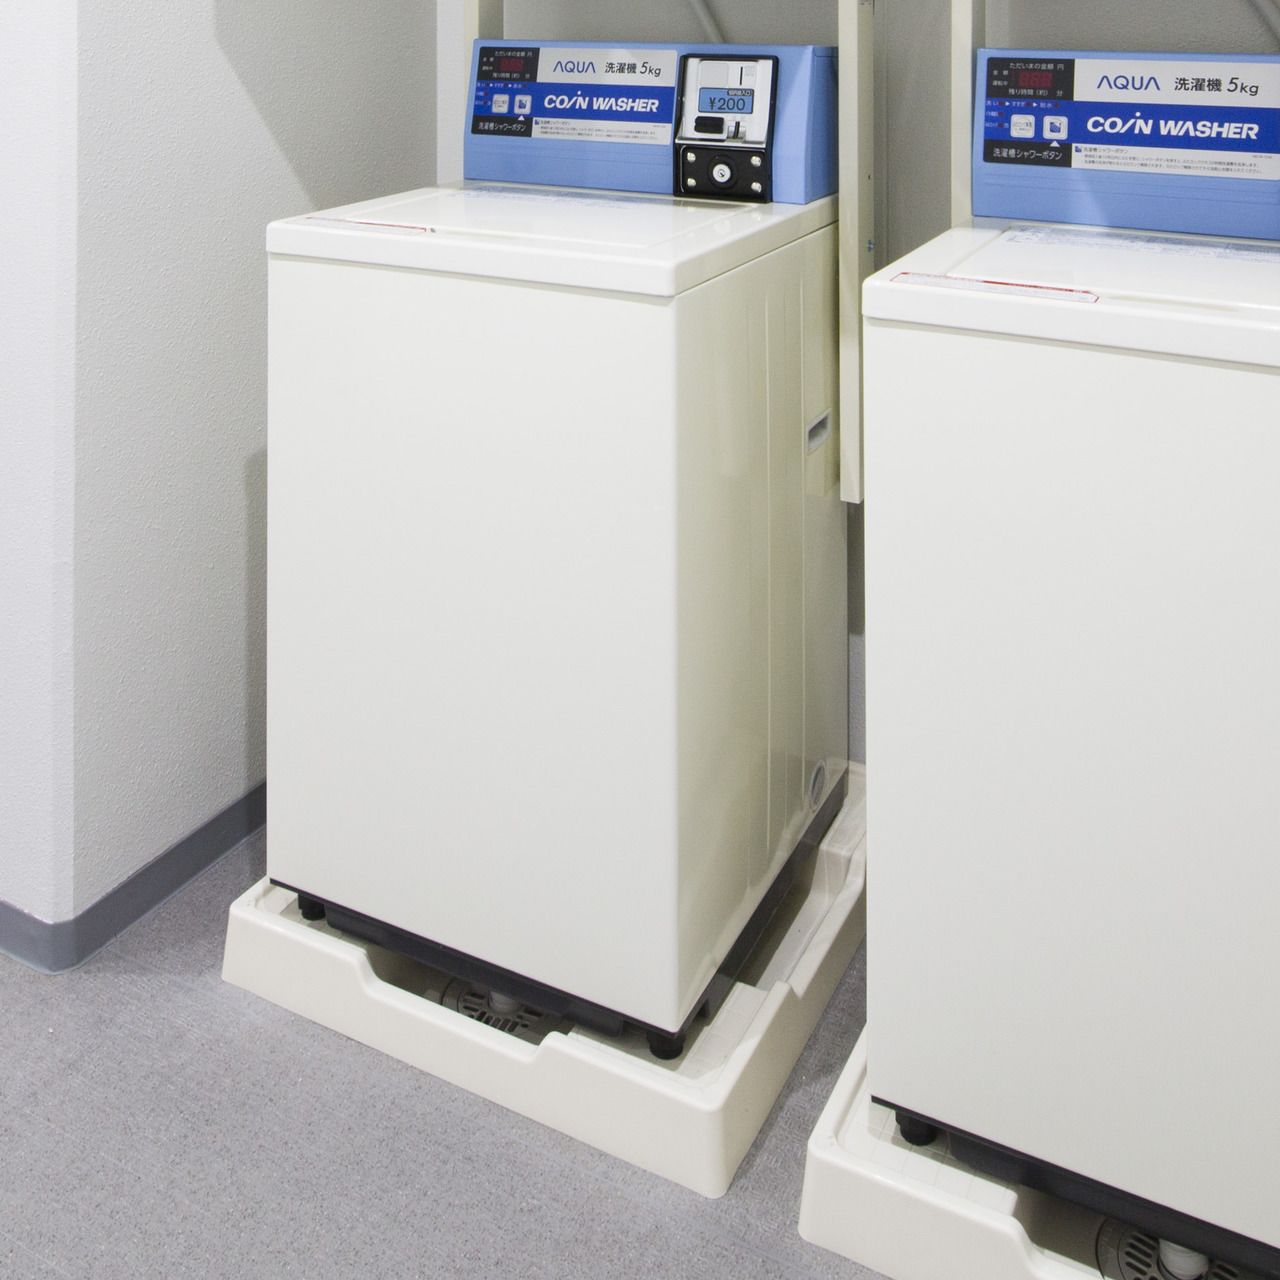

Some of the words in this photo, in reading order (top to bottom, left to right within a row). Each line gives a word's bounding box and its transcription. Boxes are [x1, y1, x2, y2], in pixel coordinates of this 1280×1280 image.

[553, 61, 596, 74] AQUA
[604, 62, 637, 74] 洗濯機
[640, 61, 662, 77] 5kg
[1097, 75, 1161, 91] AQUA
[1174, 77, 1222, 92] 洗濯機
[1227, 77, 1260, 96] 5kg
[592, 96, 660, 113] WASHER
[708, 96, 746, 111] ¥200
[1159, 120, 1260, 139] WASHER
